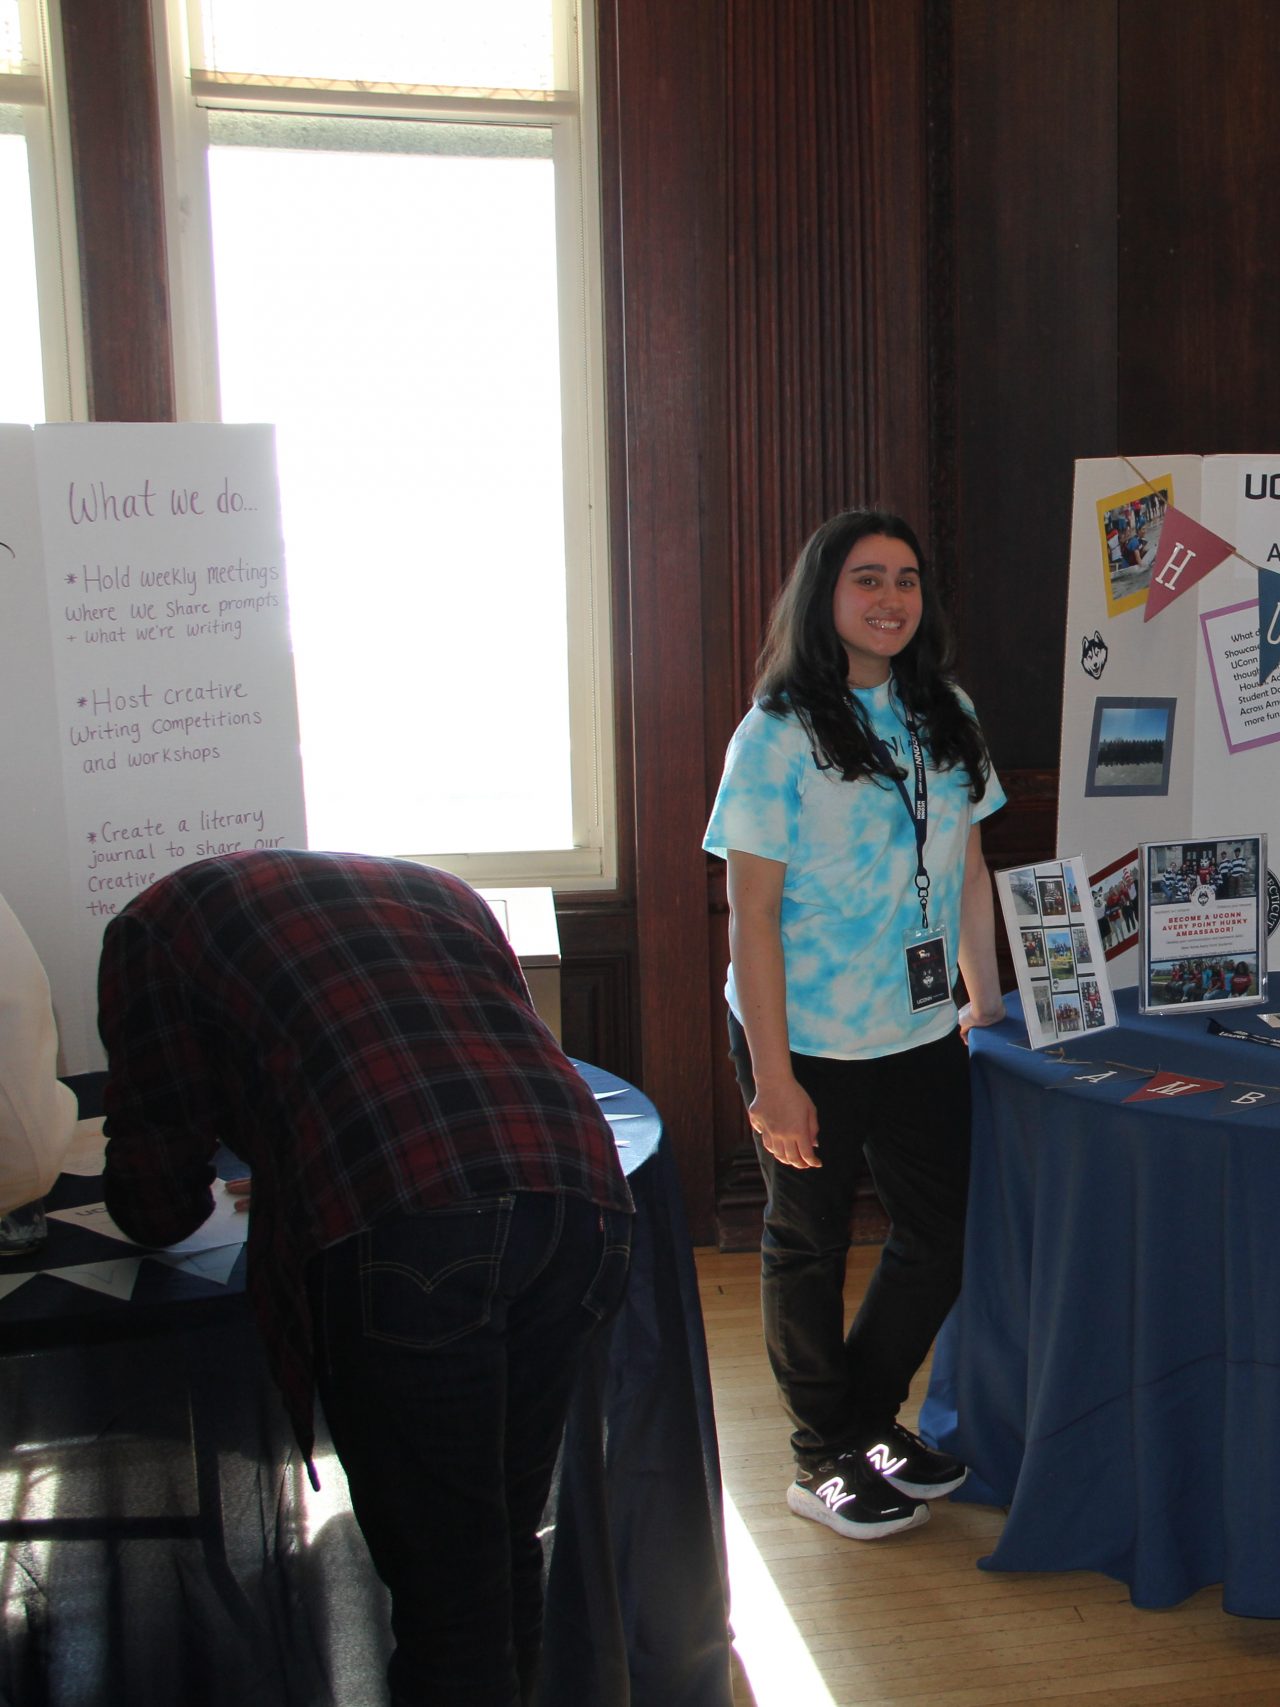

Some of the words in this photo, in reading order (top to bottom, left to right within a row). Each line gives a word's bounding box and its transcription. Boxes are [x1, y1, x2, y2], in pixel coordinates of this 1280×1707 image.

[69, 479, 157, 525] What
[171, 488, 204, 515] we
[83, 564, 131, 593] Hold
[140, 566, 197, 596] weekly
[207, 557, 279, 588] meetings
[219, 592, 279, 616] prompts
[1230, 630, 1254, 643] What
[1230, 657, 1258, 669] UConn
[93, 684, 153, 716] Host
[164, 680, 248, 705] creative
[1238, 691, 1269, 705] Student
[1240, 704, 1264, 716] Across
[1244, 715, 1265, 727] more
[1266, 711, 1280, 722] fun
[83, 751, 117, 774] and
[128, 746, 220, 769] workshops
[102, 818, 165, 843] Create
[178, 818, 190, 832] a
[201, 808, 265, 831] literary
[88, 843, 155, 869] journal
[166, 840, 185, 859] to
[86, 901, 120, 916] the
[1162, 923, 1189, 931] AVERY
[1192, 920, 1217, 928] POINT
[1220, 918, 1248, 926] HUSKY
[1168, 915, 1201, 924] BECOME
[1213, 911, 1242, 919] UCONN
